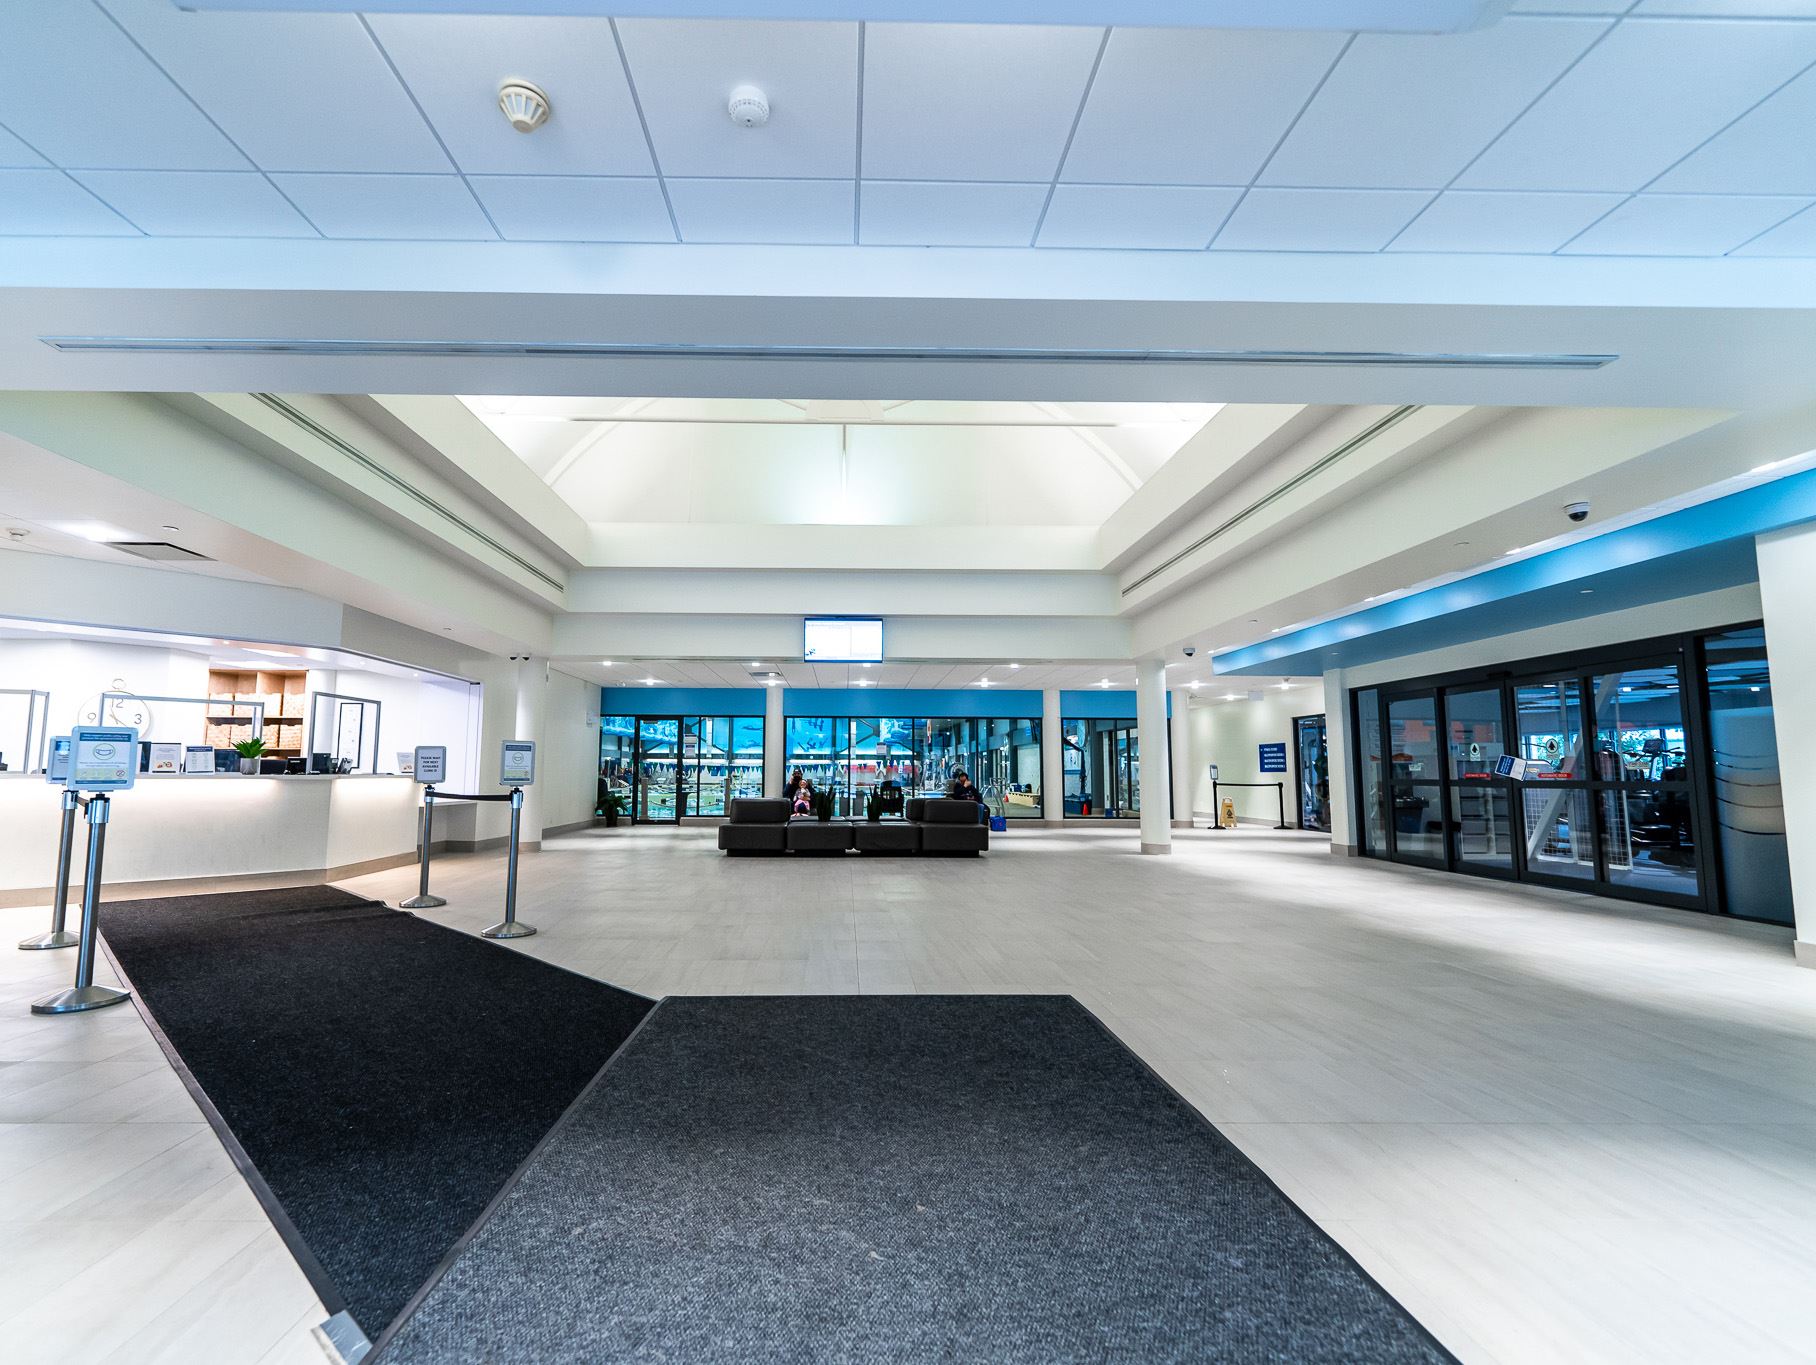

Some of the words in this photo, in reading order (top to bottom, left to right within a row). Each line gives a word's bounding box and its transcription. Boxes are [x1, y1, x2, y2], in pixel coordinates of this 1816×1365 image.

[111, 698, 124, 708] 12
[87, 712, 97, 723] 9
[134, 714, 142, 724] 3
